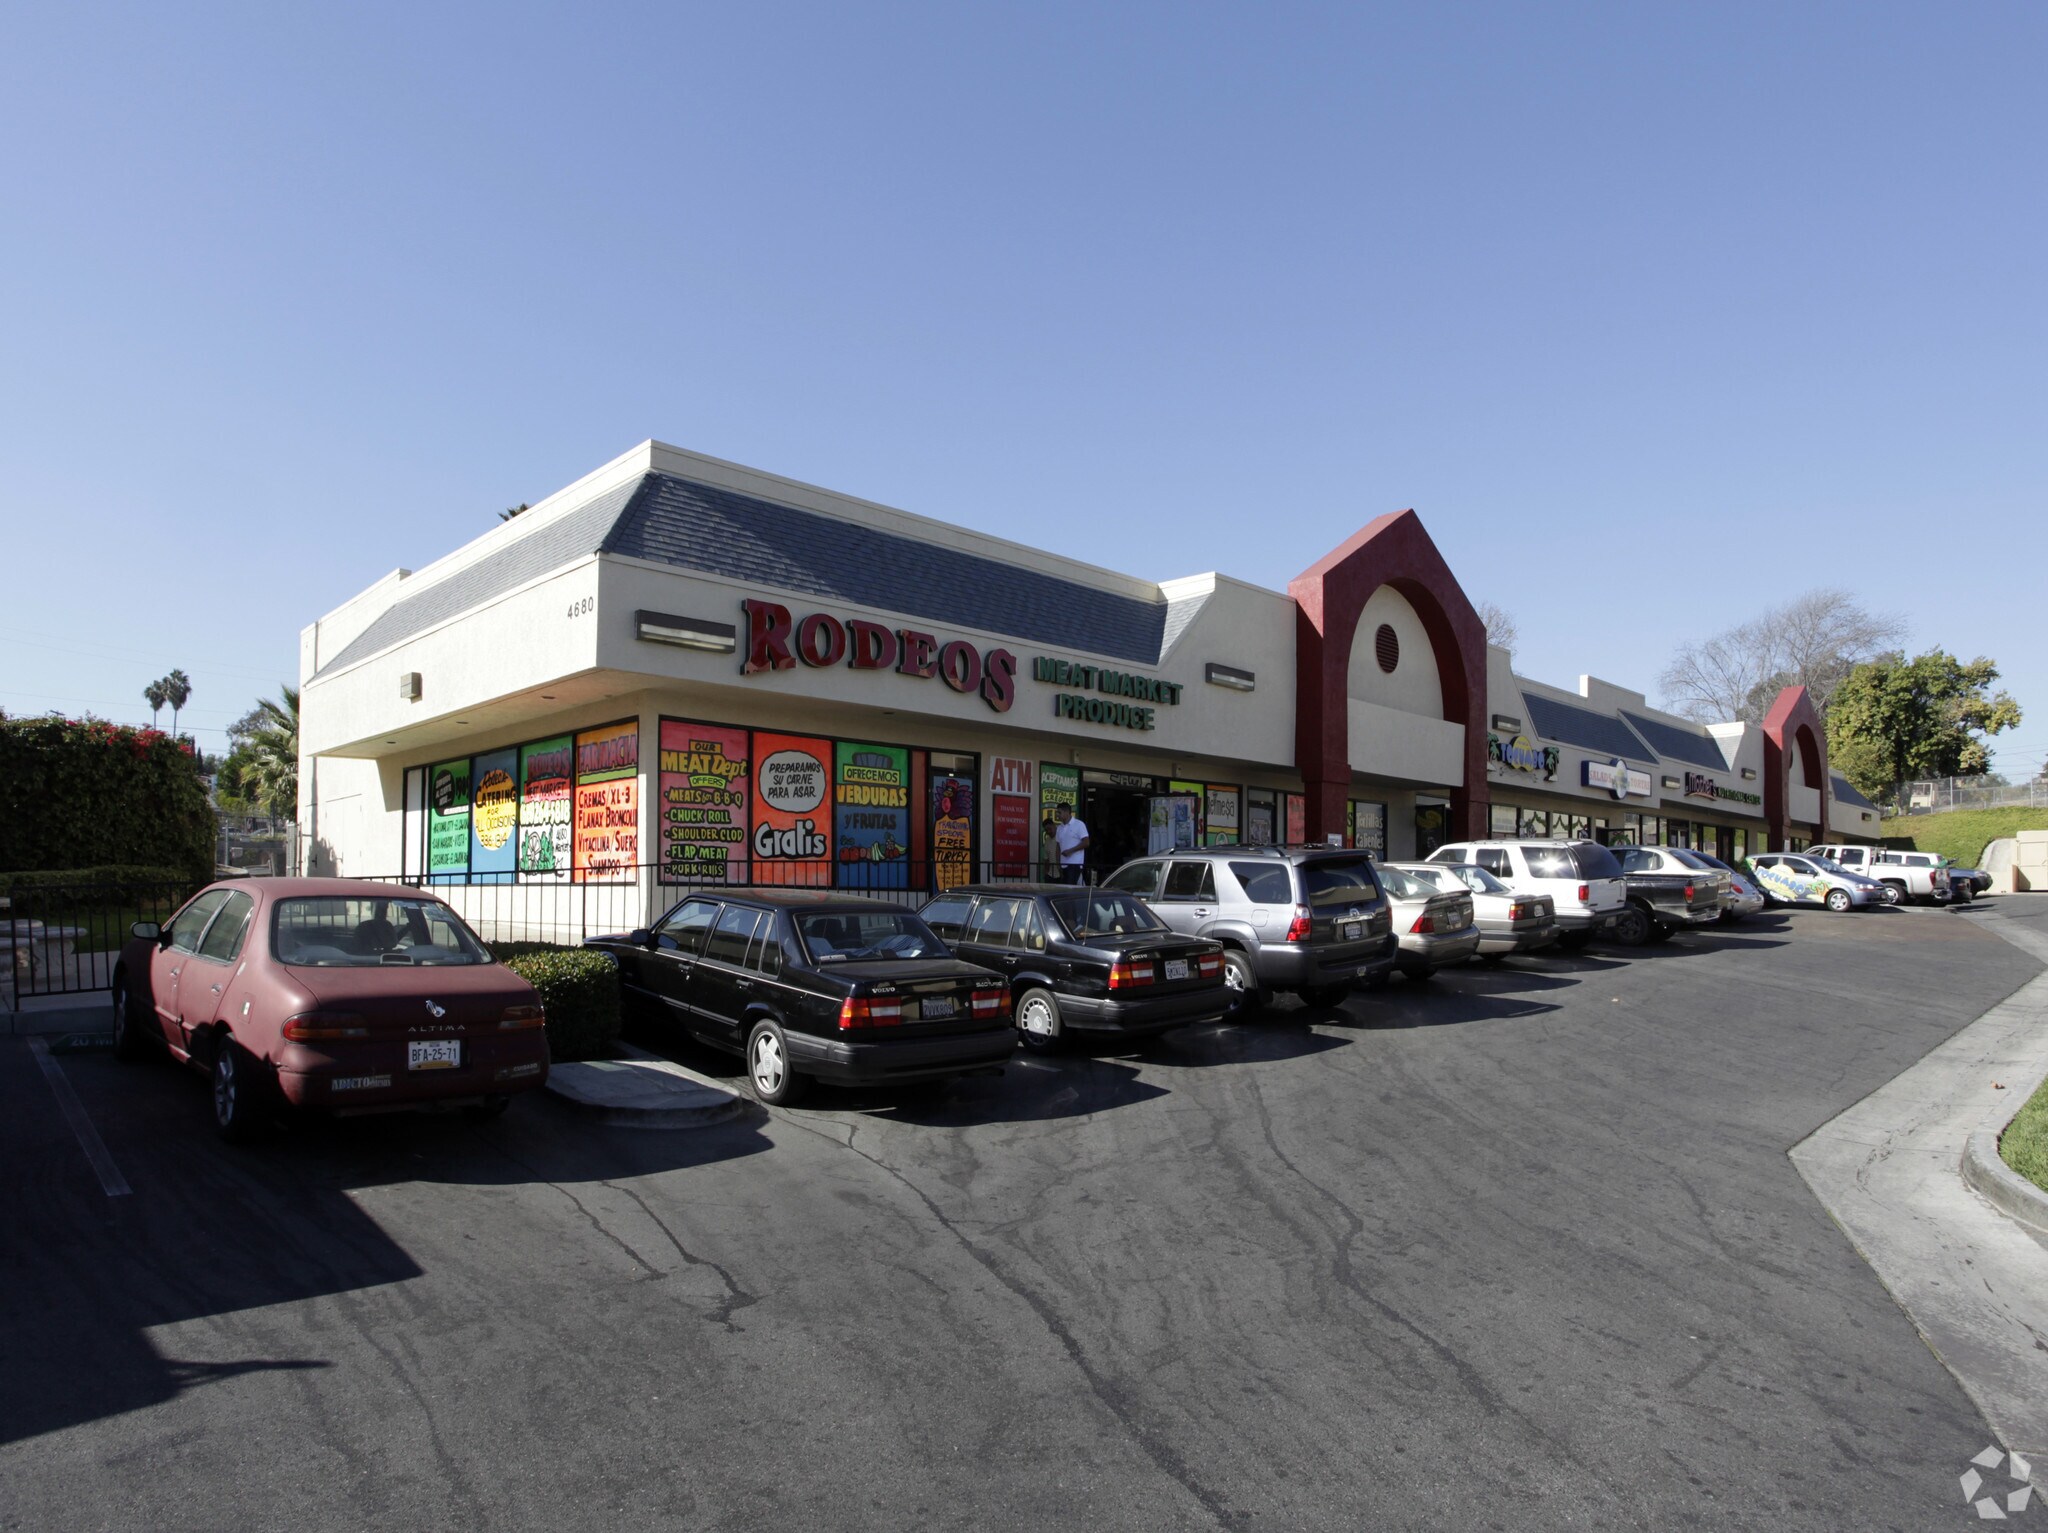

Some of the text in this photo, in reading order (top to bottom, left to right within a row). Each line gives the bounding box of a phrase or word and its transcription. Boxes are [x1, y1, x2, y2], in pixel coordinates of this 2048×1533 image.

[567, 596, 594, 619] 4680
[741, 598, 1017, 713] RODEOS
[1033, 656, 1184, 705] MEAT MARKET
[1055, 693, 1155, 731] PRODUCE
[578, 734, 637, 773] FARMACIA
[695, 743, 716, 751] OUR
[661, 750, 748, 781] MEAT Dept
[769, 762, 821, 774] PREPARAMOS
[692, 776, 723, 787] OFFERS
[773, 774, 813, 785] SU CARNE
[846, 768, 898, 783] OFRECEMOS
[991, 758, 1031, 793] ATM
[1041, 772, 1078, 787] ACEPTAMOS
[475, 785, 517, 809] CATERING
[668, 788, 701, 803] MEATS
[768, 786, 816, 799] PARA ASAR
[836, 784, 907, 807] VERDURAS
[578, 809, 604, 829] FLANAX
[670, 809, 731, 823] CHUCK ROLL
[854, 813, 897, 830] FRUTAS
[671, 827, 743, 841] SHOULDER CLOD
[755, 819, 825, 858] Gratis
[938, 837, 965, 848] FREE
[671, 845, 728, 860] FLAP MEAT
[936, 850, 968, 864] TURKEY
[588, 854, 621, 875] SHAMPOO
[408, 1024, 466, 1033] ALTIMA
[412, 1047, 457, 1062] BFA-25-71
